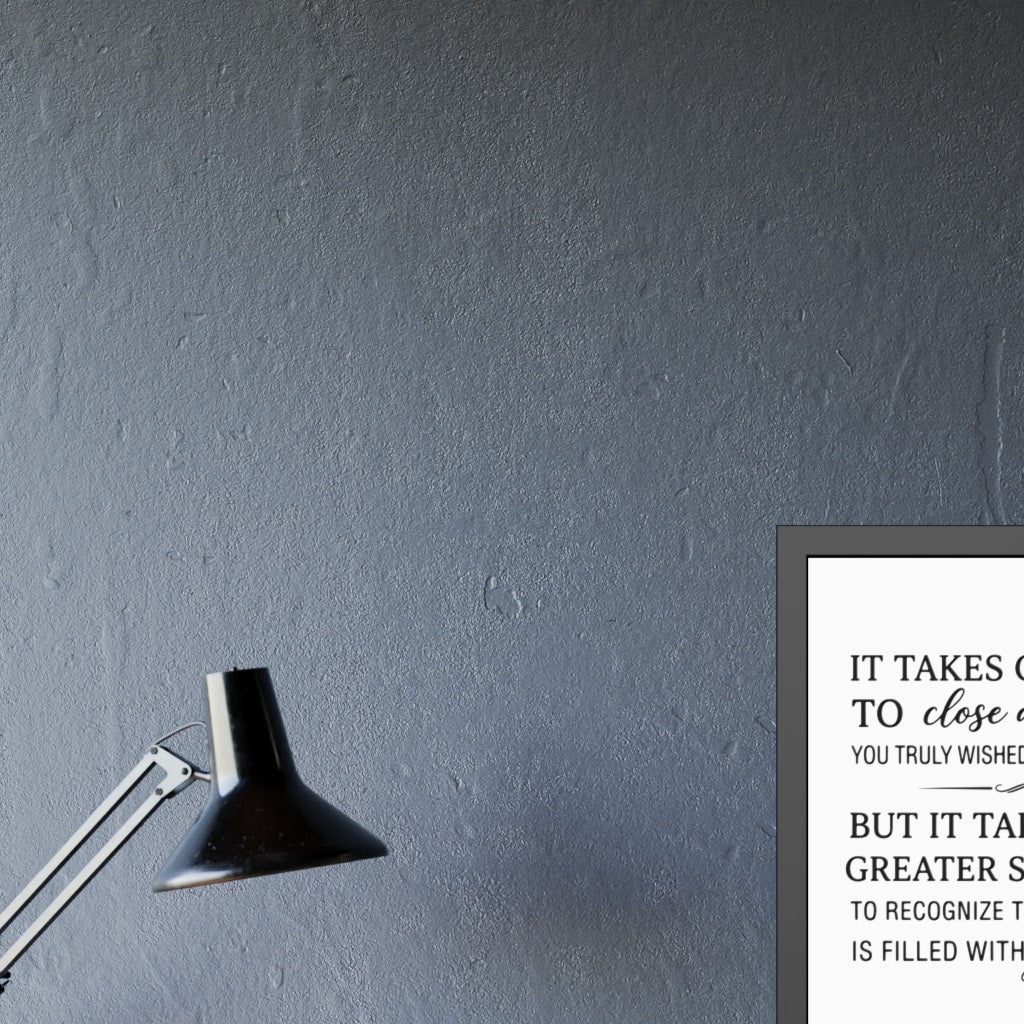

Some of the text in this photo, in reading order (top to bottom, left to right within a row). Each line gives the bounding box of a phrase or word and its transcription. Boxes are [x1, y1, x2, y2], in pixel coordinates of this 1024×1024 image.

[851, 654, 883, 682] IT
[894, 654, 1004, 682] TAKES
[852, 698, 904, 729] TO
[924, 687, 1009, 733] close
[851, 745, 889, 765] YOU
[895, 745, 952, 765] TRULY
[849, 812, 919, 839] BUT
[929, 812, 963, 839] IT
[846, 855, 999, 883] GREATER
[851, 900, 877, 921] TO
[886, 900, 1004, 921] RECOGNIZE
[852, 940, 873, 962] IS
[882, 940, 957, 962] FILLED
[966, 940, 1024, 962] WITH
